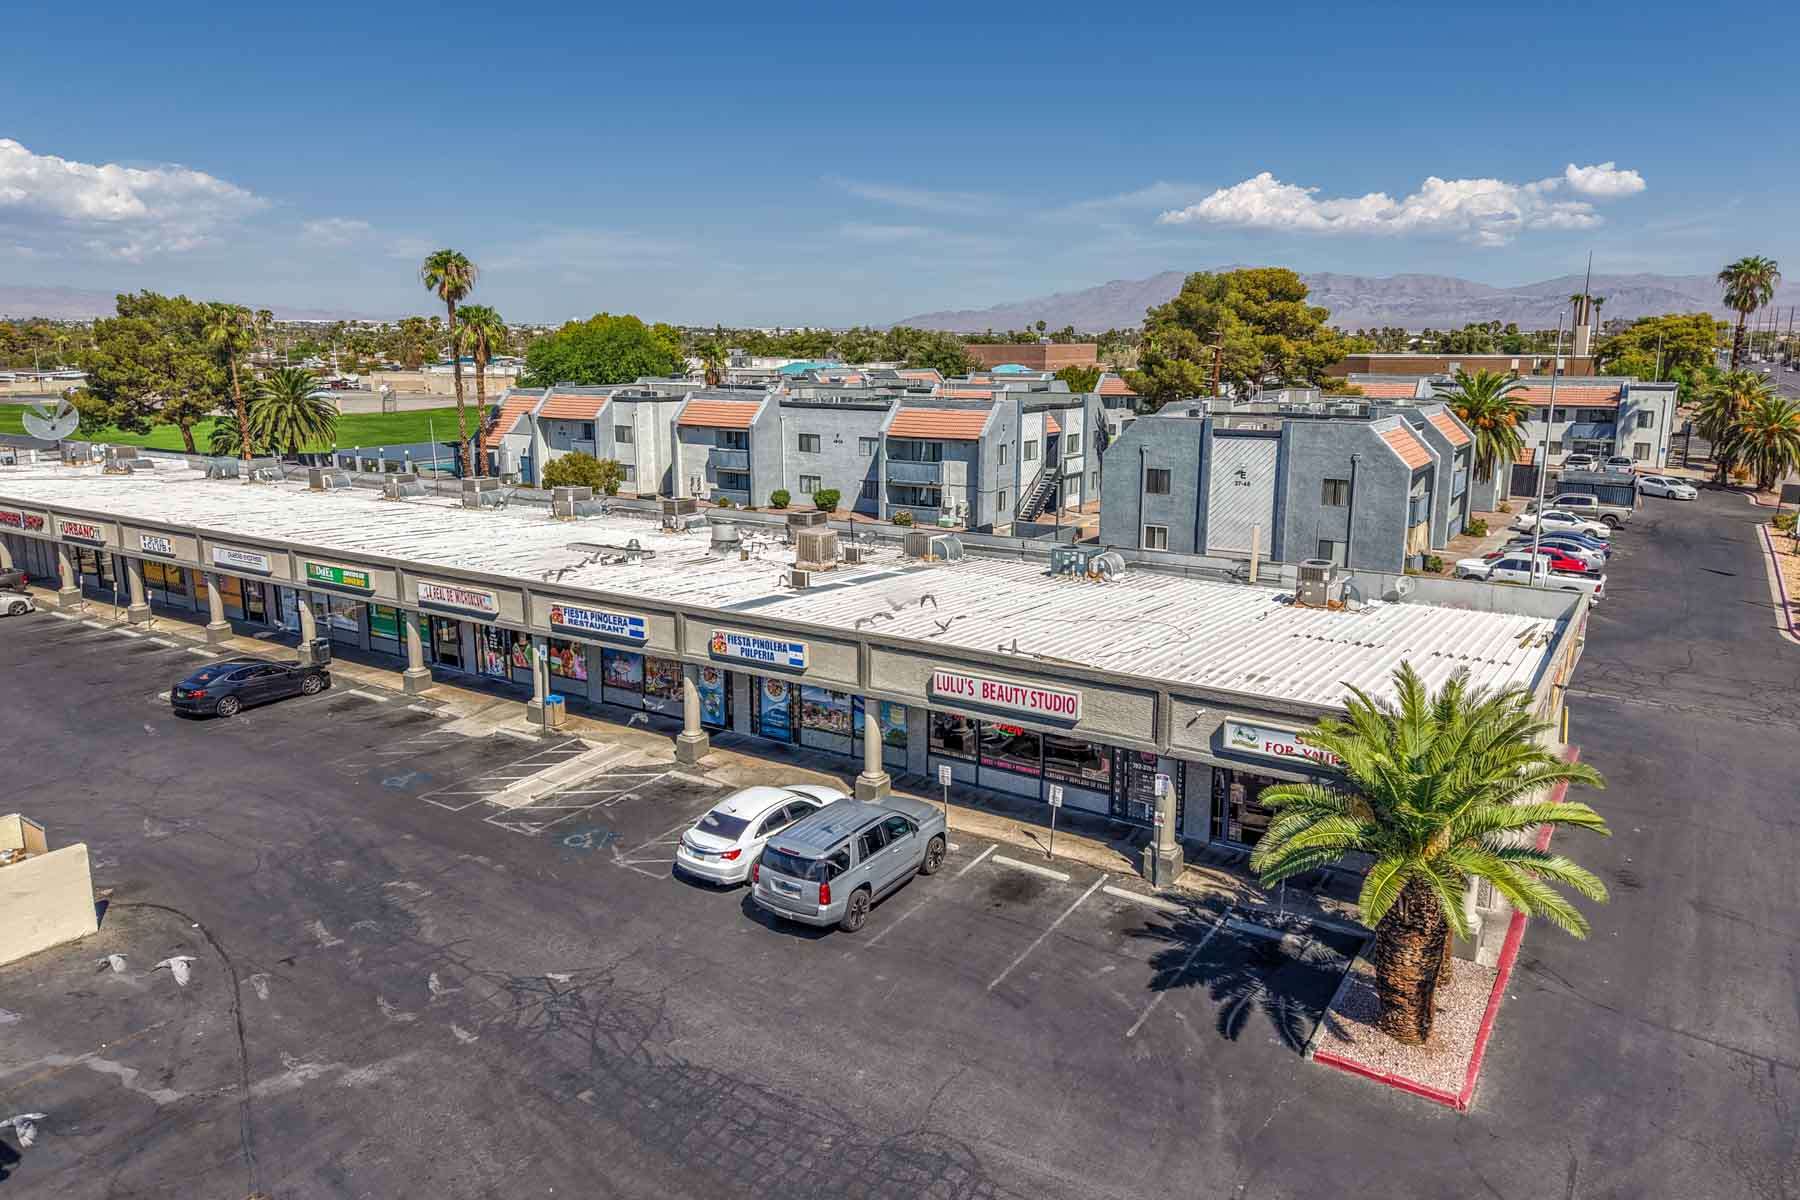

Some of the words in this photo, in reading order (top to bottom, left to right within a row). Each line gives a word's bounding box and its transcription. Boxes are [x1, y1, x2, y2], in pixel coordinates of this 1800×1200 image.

[63, 520, 94, 538] URBANO
[147, 541, 167, 552] CLUB
[433, 587, 446, 601] REAL
[447, 589, 454, 603] DE
[563, 607, 589, 621] FIESTA
[590, 612, 629, 627] PINOLERA
[568, 618, 625, 634] RESTAURANT
[727, 634, 751, 647] FIESTA
[752, 638, 789, 653] PINOLERA
[740, 647, 775, 661] PULPERIA
[936, 674, 974, 697] LULU'S
[982, 682, 1028, 706] BEAUTY
[1030, 691, 1075, 714] STUDIO
[992, 723, 1024, 736] OPEN
[1265, 742, 1294, 755] FOR
